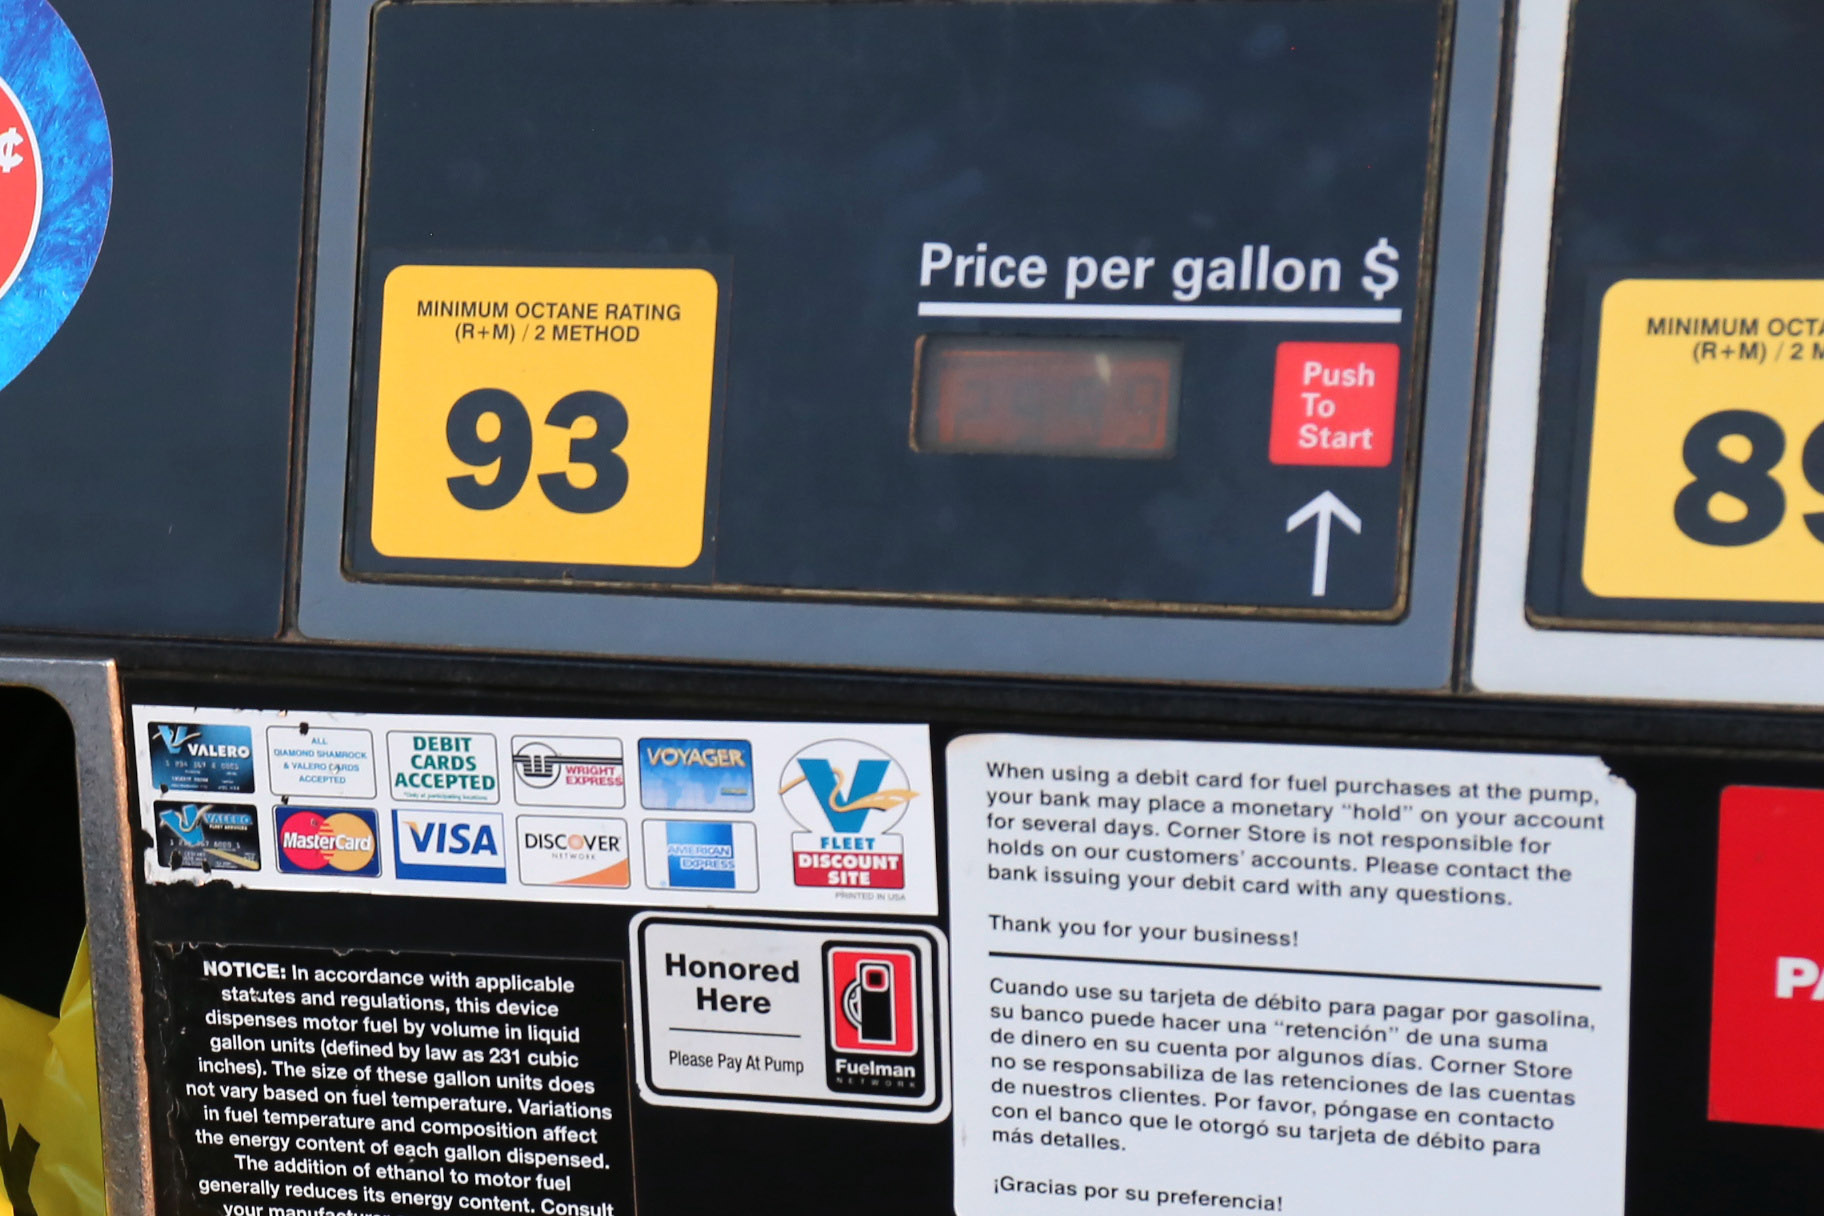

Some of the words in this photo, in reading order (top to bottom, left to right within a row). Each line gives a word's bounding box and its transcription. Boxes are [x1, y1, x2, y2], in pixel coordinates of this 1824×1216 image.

[920, 242, 1048, 289] Price
[1065, 255, 1156, 300] per
[1172, 244, 1341, 301] gallon
[1361, 237, 1399, 301] $
[417, 300, 508, 318] MINIMUM
[515, 301, 598, 320] OCTANE
[605, 303, 680, 321] RATING
[455, 322, 516, 344] (R+M)
[534, 324, 545, 341] 2
[552, 324, 640, 343] METHOD
[1646, 317, 1760, 336] MINIMUM
[1692, 341, 1768, 364] (R+M)
[1789, 342, 1805, 361] 2
[1297, 358, 1379, 389] Push
[1301, 392, 1336, 418] To
[1295, 422, 1376, 453] Start
[441, 383, 634, 518] 93
[1673, 409, 1824, 547] 8
[187, 743, 250, 759] VALERO
[311, 737, 328, 745] ALL
[412, 735, 473, 752] DEBIT
[273, 748, 315, 758] DIAMOND
[316, 750, 368, 760] SHAMROCK
[410, 754, 477, 771] CARDS
[647, 747, 747, 767] VOYAGER
[283, 762, 290, 770] &
[291, 762, 327, 771] VALERO
[565, 765, 616, 776] WRIGHT
[297, 775, 348, 785] ACCEPTED
[394, 771, 497, 792] ACCEPTED
[565, 775, 624, 786] EXPRESS
[204, 813, 253, 825] VALERO
[281, 831, 371, 852] MasterCard
[409, 822, 498, 856] VISA
[525, 833, 619, 852] DISCOVER
[819, 836, 876, 850] FLEET
[551, 853, 596, 861] NETWORK
[667, 844, 730, 856] AMERICAN
[682, 858, 736, 869] EXPRESS
[797, 854, 899, 870] DISCOUNT
[827, 870, 871, 886] SITE
[834, 891, 874, 901] PRINTED
[887, 893, 907, 902] USA
[988, 913, 1051, 933] Thank
[1058, 921, 1096, 939] you
[1102, 920, 1133, 938] for
[1138, 926, 1187, 943] your
[1193, 925, 1298, 947] business!
[203, 960, 286, 980] NOTICE:
[291, 964, 309, 981] In
[314, 967, 424, 986] accordance
[429, 971, 470, 988] with
[475, 974, 575, 994] applicable
[665, 952, 800, 984] Honored
[221, 986, 296, 1005] statutes
[300, 990, 335, 1007] and
[340, 992, 450, 1015] regulations,
[454, 996, 491, 1014] this
[495, 998, 559, 1017] device
[696, 987, 771, 1014] Here
[669, 1049, 713, 1068] Please
[717, 1052, 743, 1073] Pay
[745, 1055, 761, 1071] At
[764, 1055, 804, 1077] Pump
[836, 1058, 916, 1078] Fuelman
[836, 1076, 915, 1088] NETWORK
[994, 1175, 1078, 1197] ¡Gracias
[1084, 1185, 1119, 1201] por
[1125, 1188, 1150, 1202] su
[1157, 1189, 1283, 1212] preferencia!
